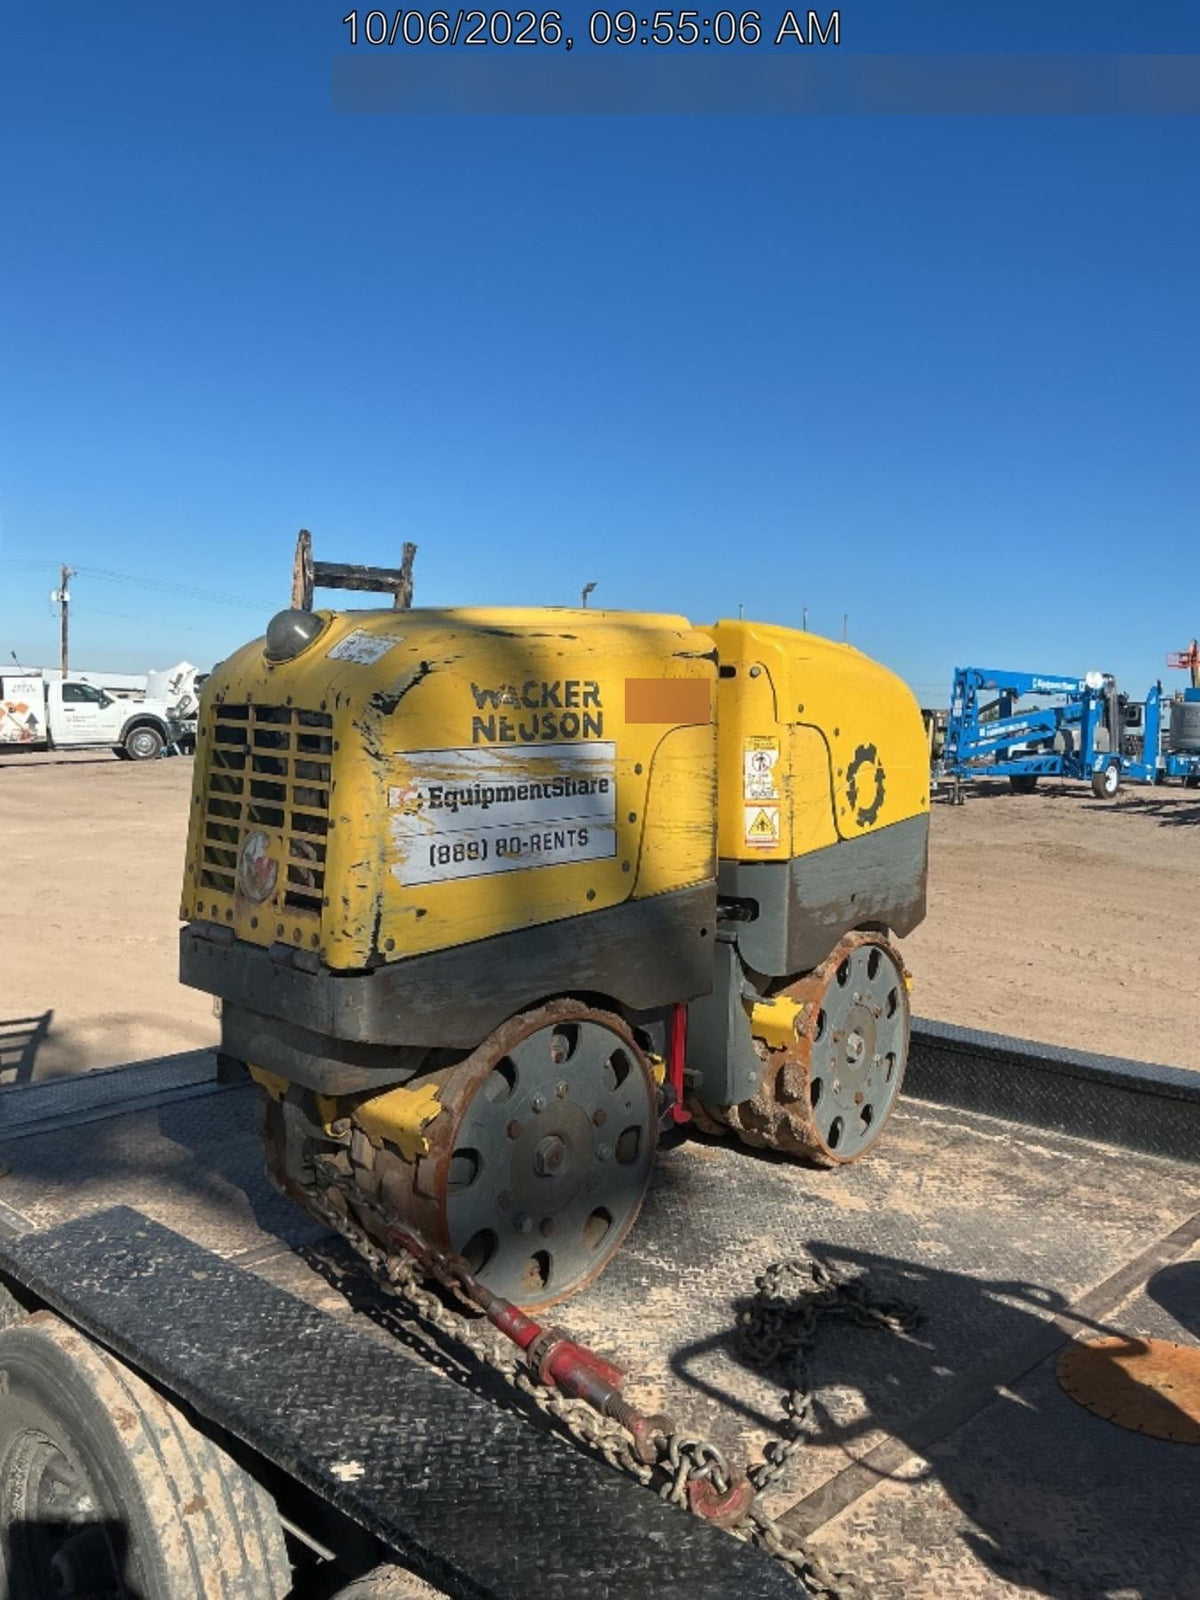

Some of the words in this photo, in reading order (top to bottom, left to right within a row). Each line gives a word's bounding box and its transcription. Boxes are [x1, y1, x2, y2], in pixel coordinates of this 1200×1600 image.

[428, 777, 608, 812] EquipmentShare
[430, 839, 487, 866] (888)
[496, 829, 588, 856] 80-RENTS
